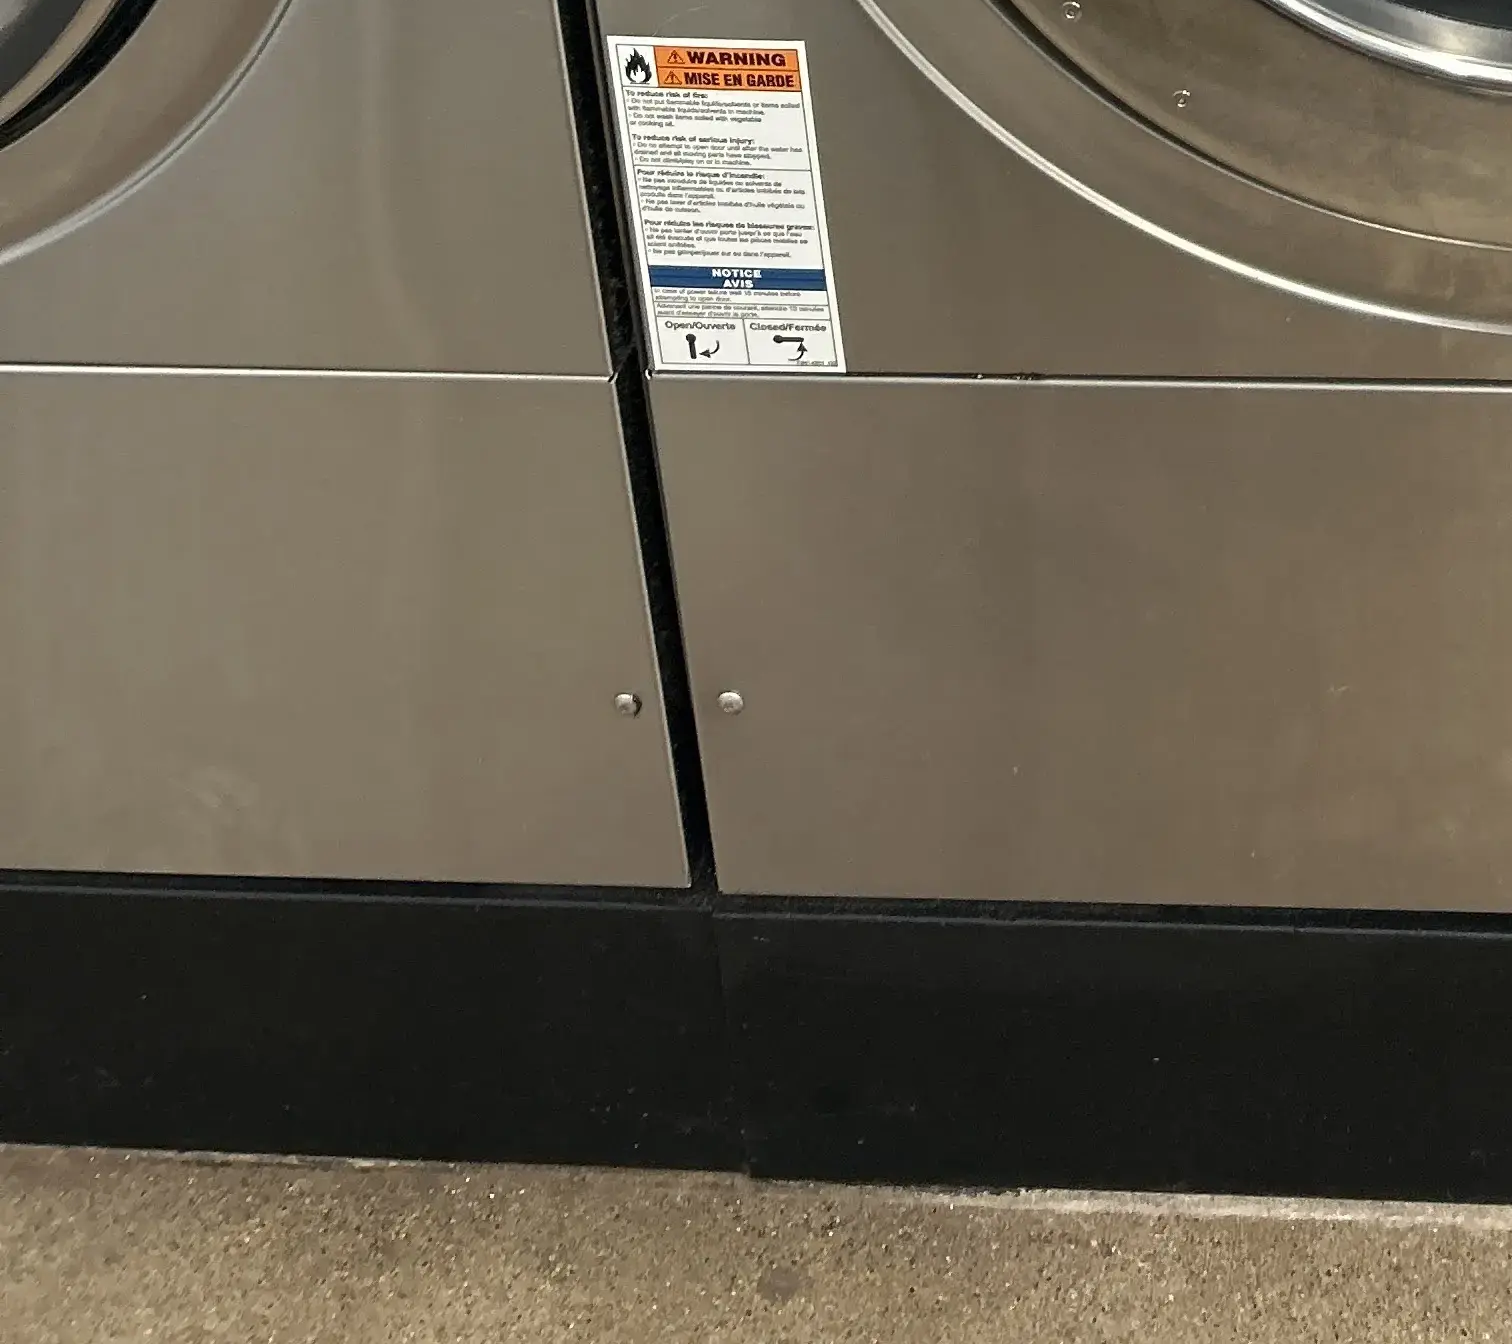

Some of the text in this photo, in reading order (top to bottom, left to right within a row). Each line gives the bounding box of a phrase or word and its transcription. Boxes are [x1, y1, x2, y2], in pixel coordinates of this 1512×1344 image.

[687, 51, 786, 66] WARNING
[684, 72, 794, 87] MISE EN GARDE
[712, 269, 762, 279] NOTICE
[723, 279, 754, 288] AVIS
[665, 321, 736, 330] Open/Ouverte
